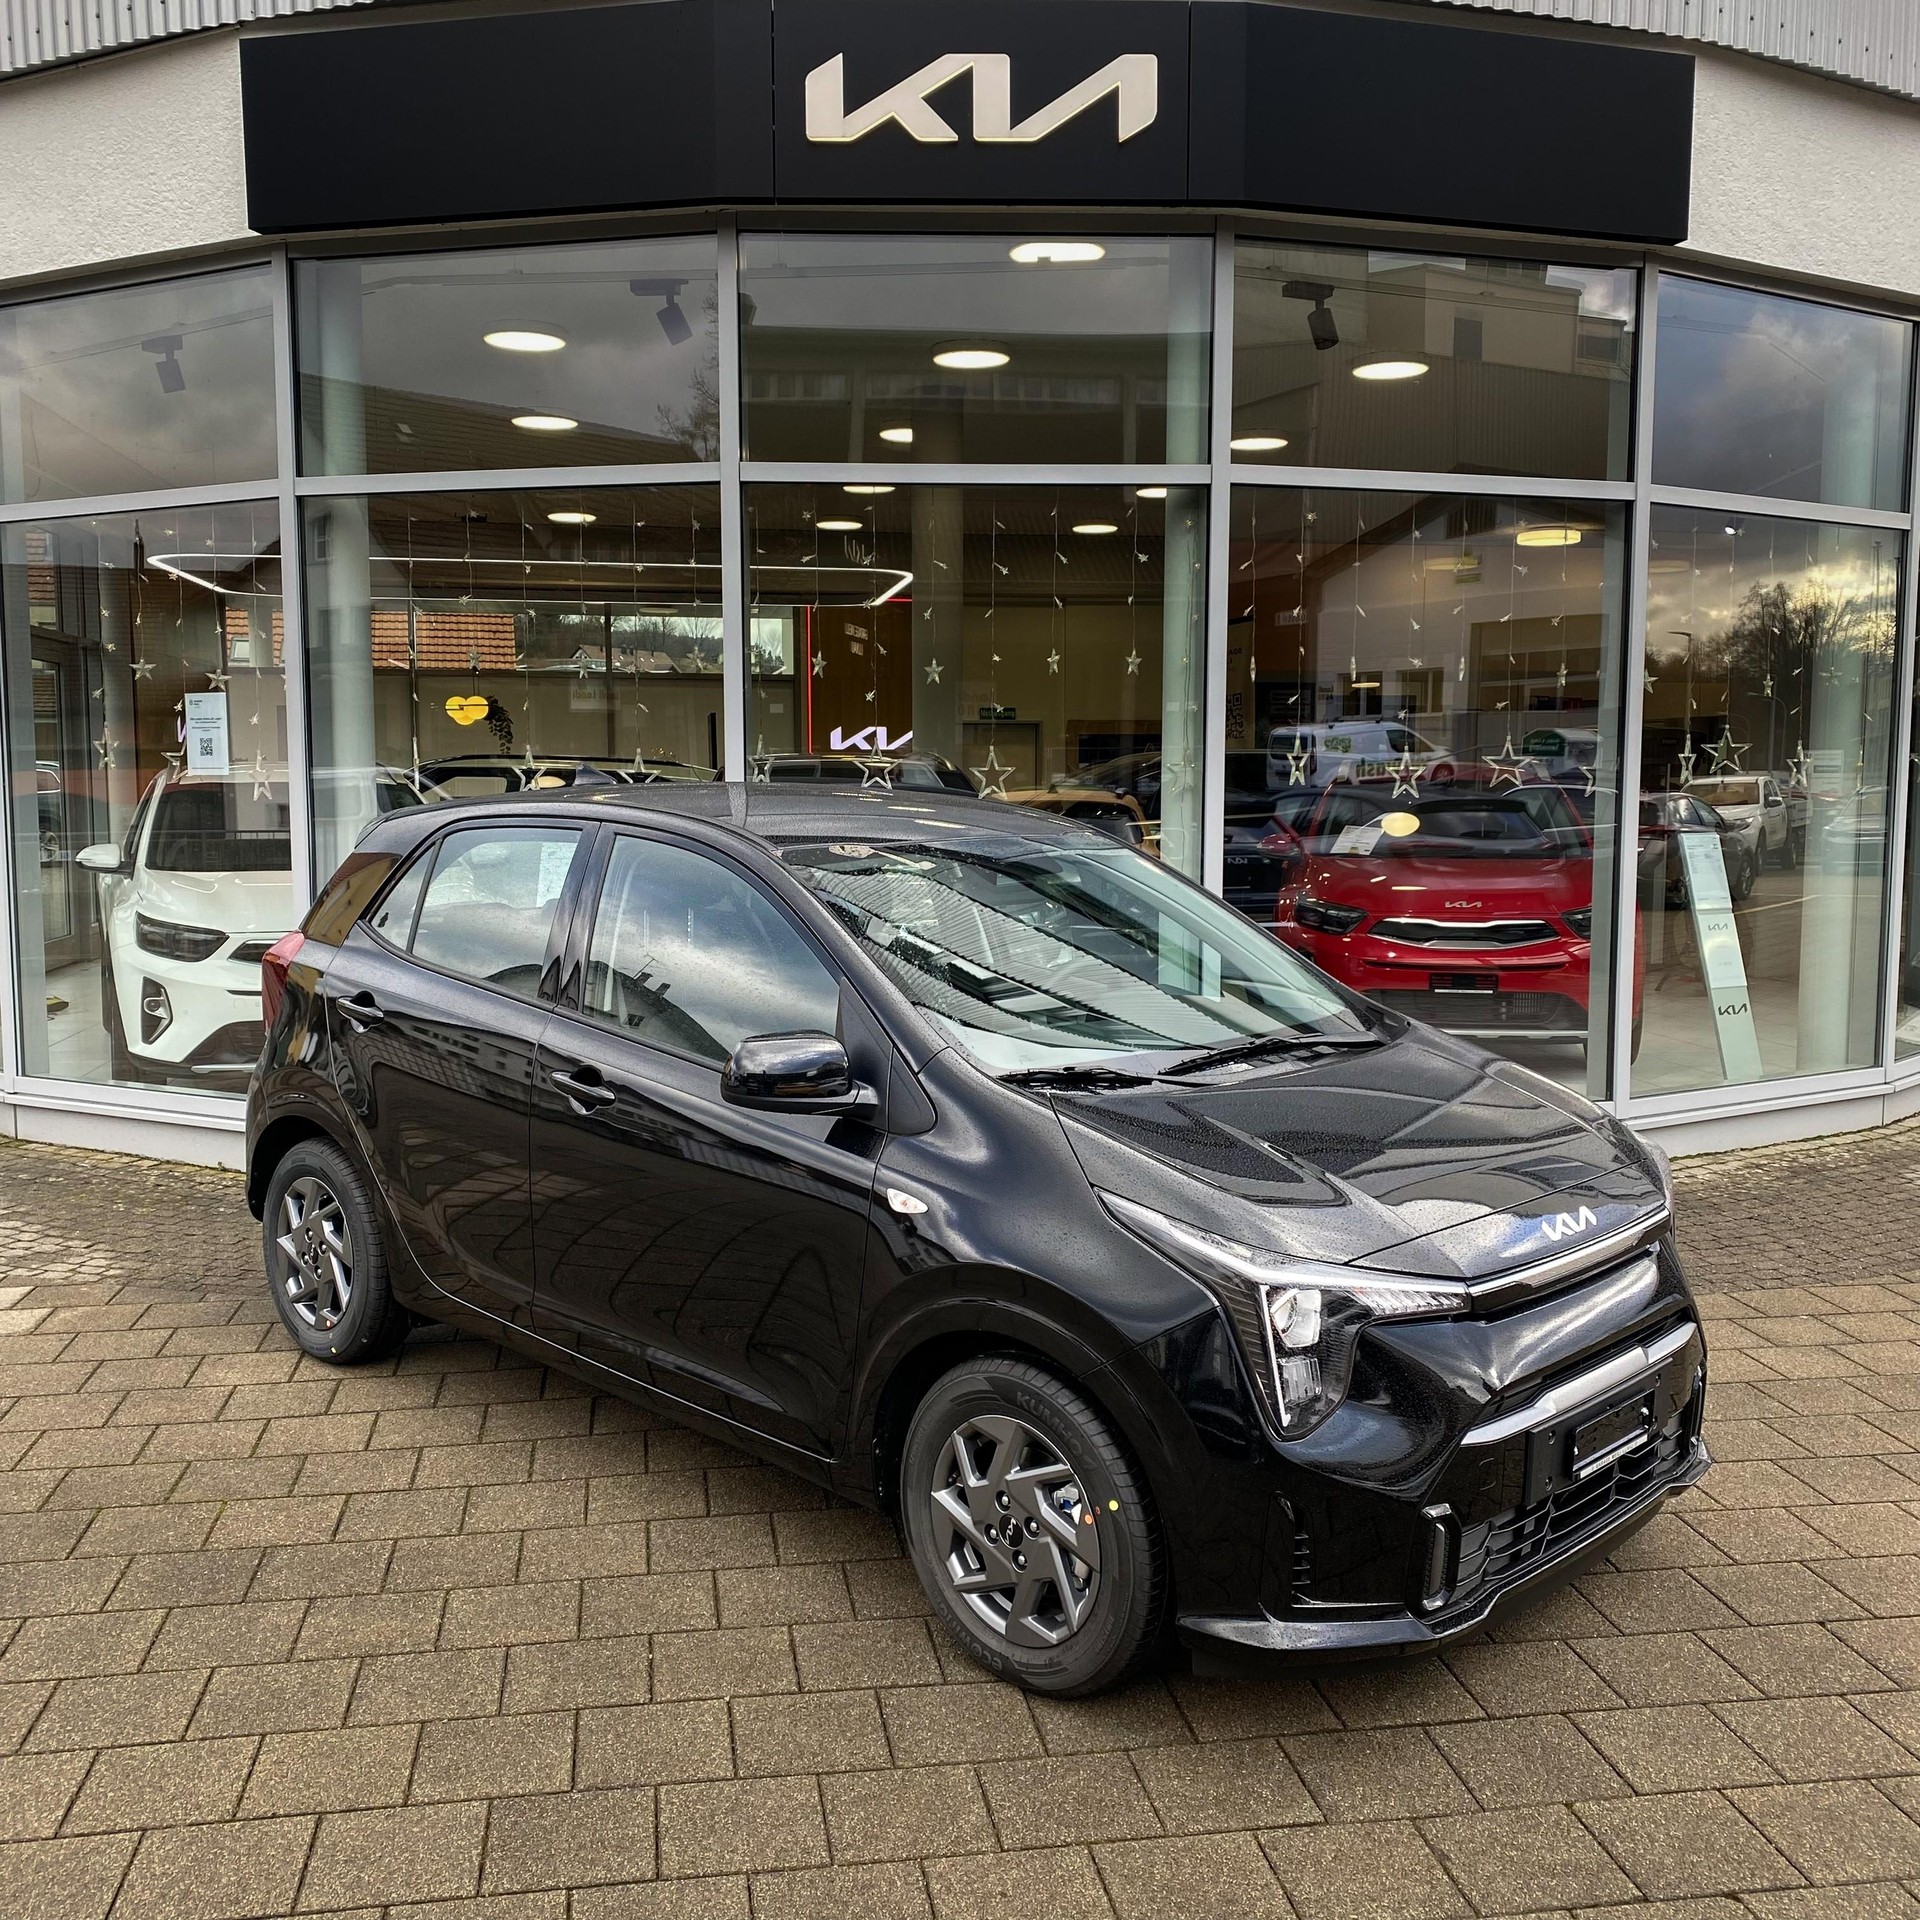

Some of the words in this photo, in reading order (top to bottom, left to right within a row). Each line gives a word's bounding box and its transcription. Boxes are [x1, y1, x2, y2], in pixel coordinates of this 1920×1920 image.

[805, 52, 1158, 142] KIA
[1707, 923, 1729, 931] KIA
[1718, 1003, 1748, 1016] KIA
[1541, 1205, 1598, 1242] KIA
[1016, 1391, 1083, 1456] KUMHO
